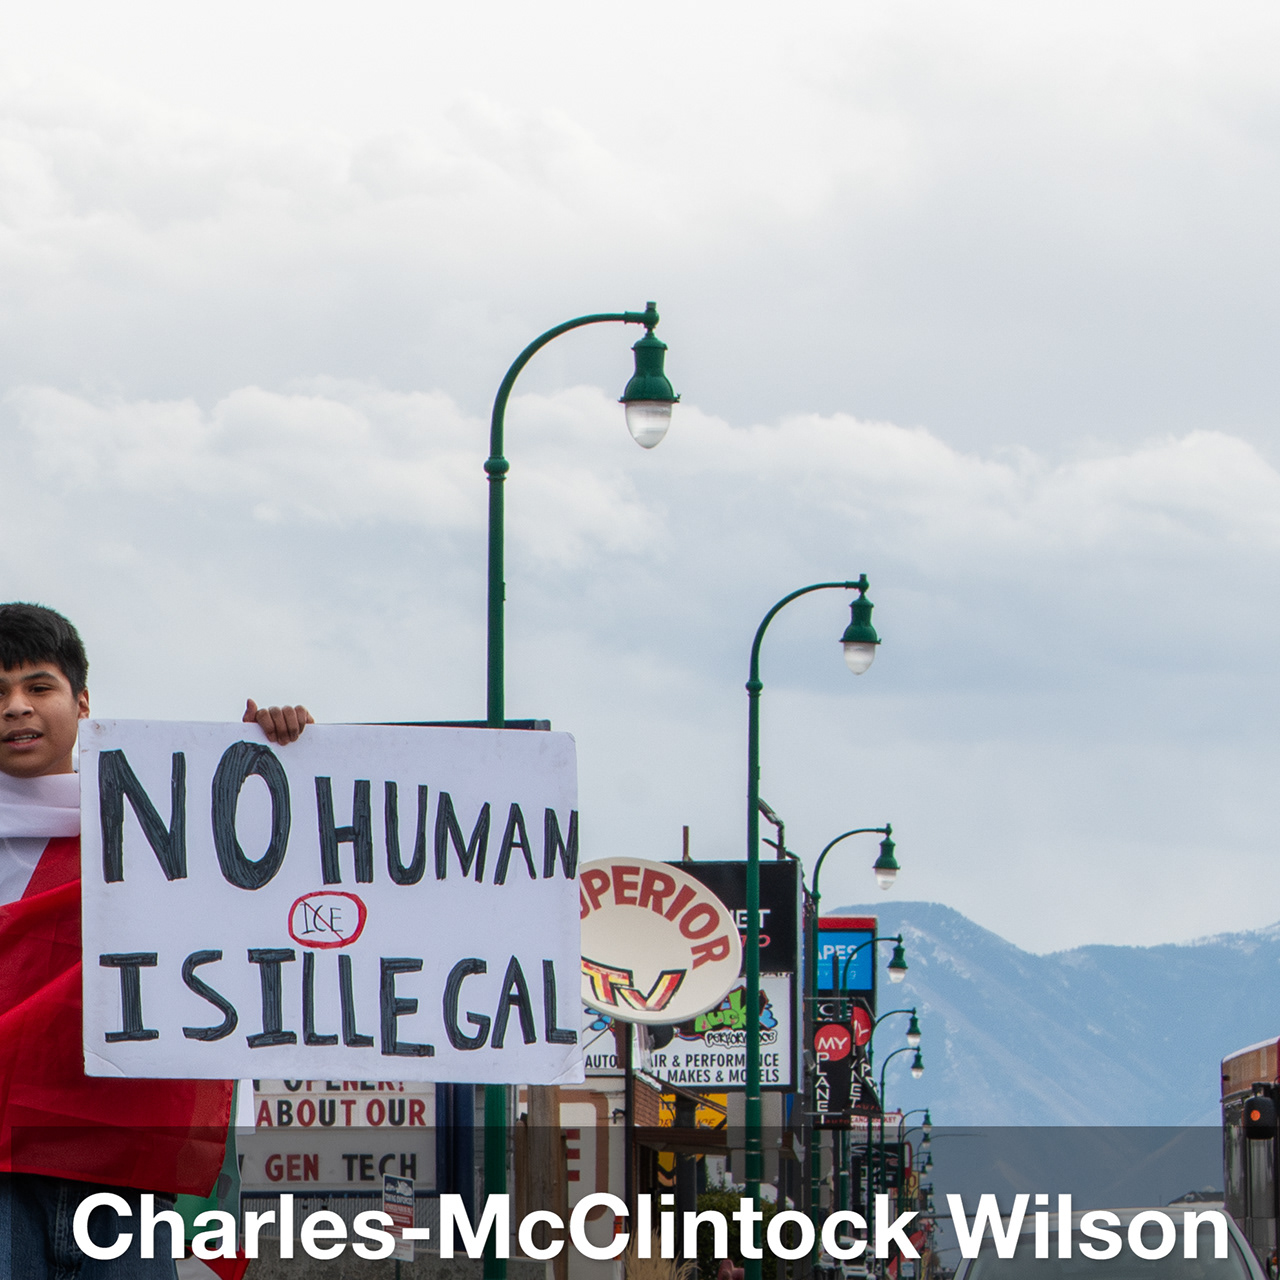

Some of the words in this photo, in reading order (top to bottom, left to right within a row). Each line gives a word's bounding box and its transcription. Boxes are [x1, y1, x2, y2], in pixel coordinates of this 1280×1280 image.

[98, 740, 291, 891] NO
[314, 776, 579, 886] HUMAN
[301, 902, 342, 935] ICE
[581, 955, 688, 1012] TV
[99, 949, 239, 1043] IS
[246, 948, 579, 1057] ILLEGAL
[818, 1036, 849, 1050] MY
[585, 1054, 618, 1068] AUTO
[671, 1054, 681, 1067] &
[667, 1069, 711, 1083] MAKES
[715, 1069, 724, 1083] &
[729, 1069, 780, 1083] MOELS
[256, 1098, 358, 1127] ABOUT
[366, 1098, 427, 1127] OUR
[265, 1153, 320, 1182] GEN
[342, 1153, 417, 1182] TECH
